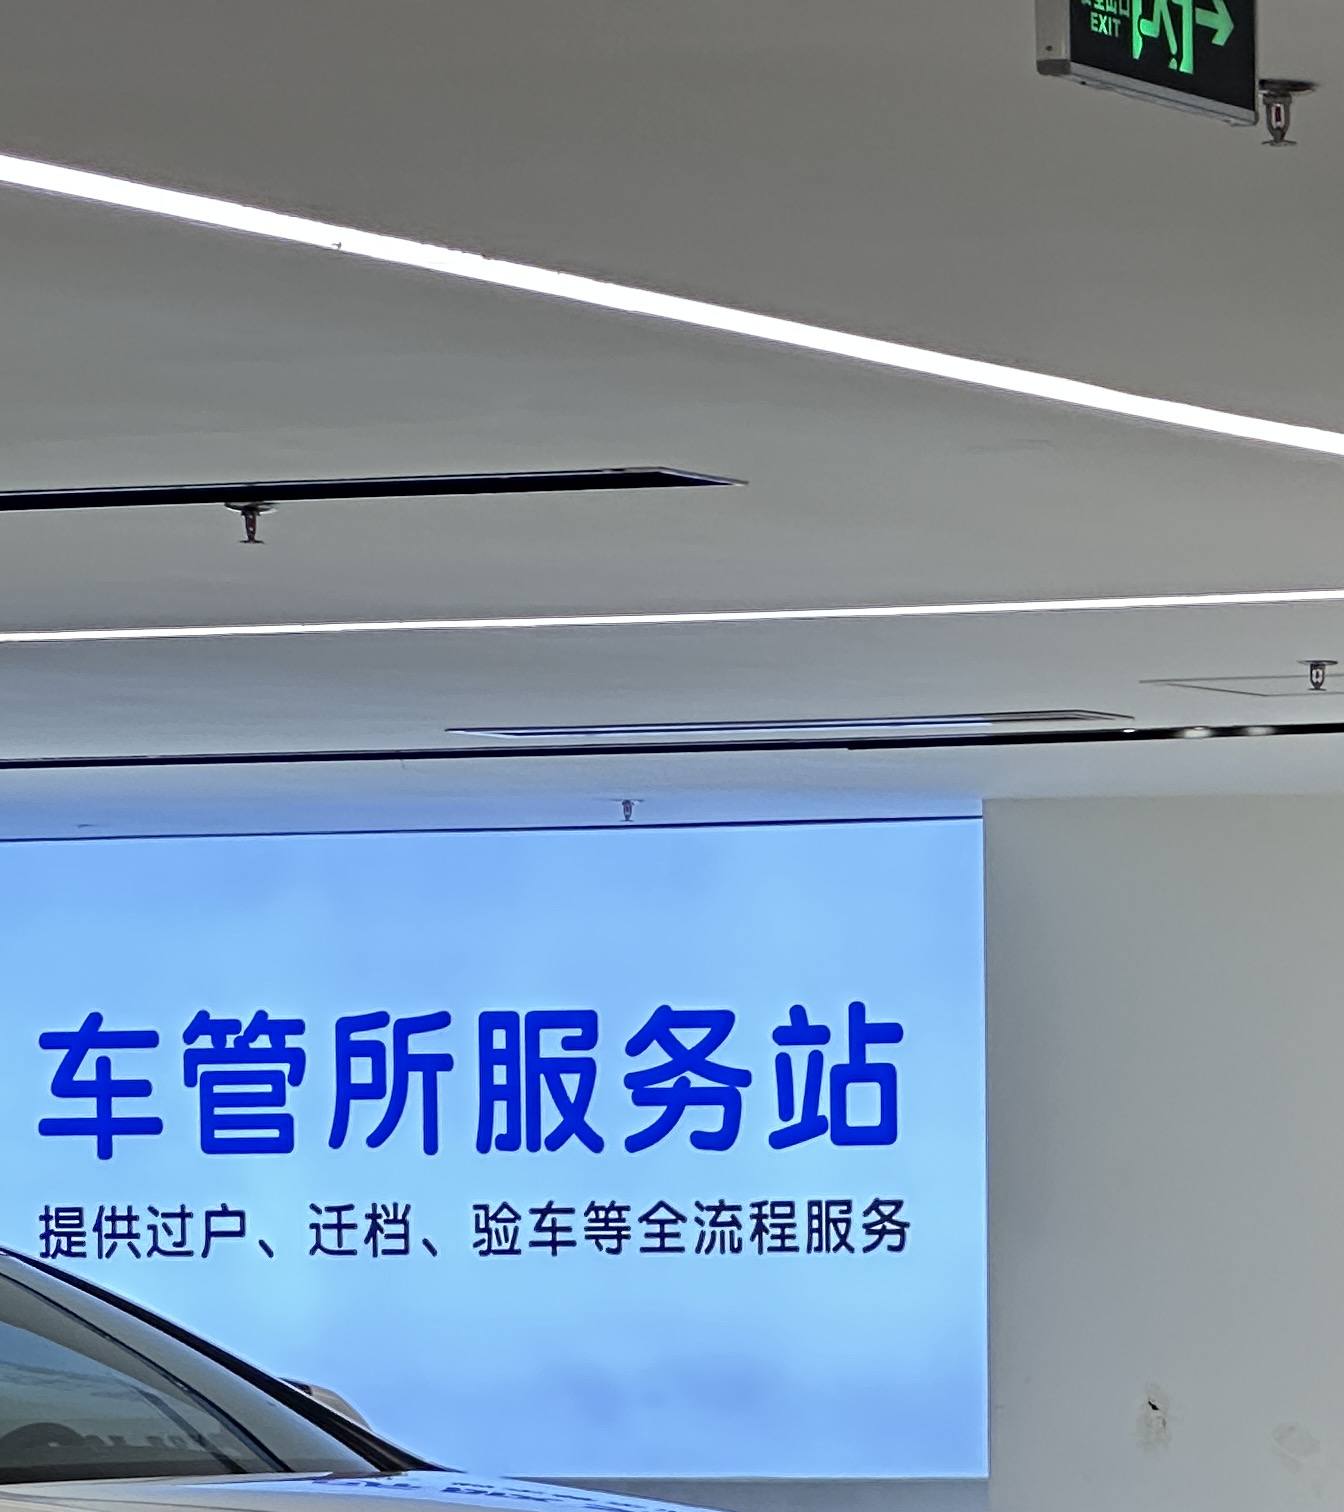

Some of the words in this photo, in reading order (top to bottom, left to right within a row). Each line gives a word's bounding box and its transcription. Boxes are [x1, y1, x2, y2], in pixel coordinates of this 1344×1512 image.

[1090, 11, 1121, 38] EXIT
[37, 1001, 905, 1161] 车管所服务站
[37, 1199, 913, 1259] 提供过户、迁档、验车等全流程服务
